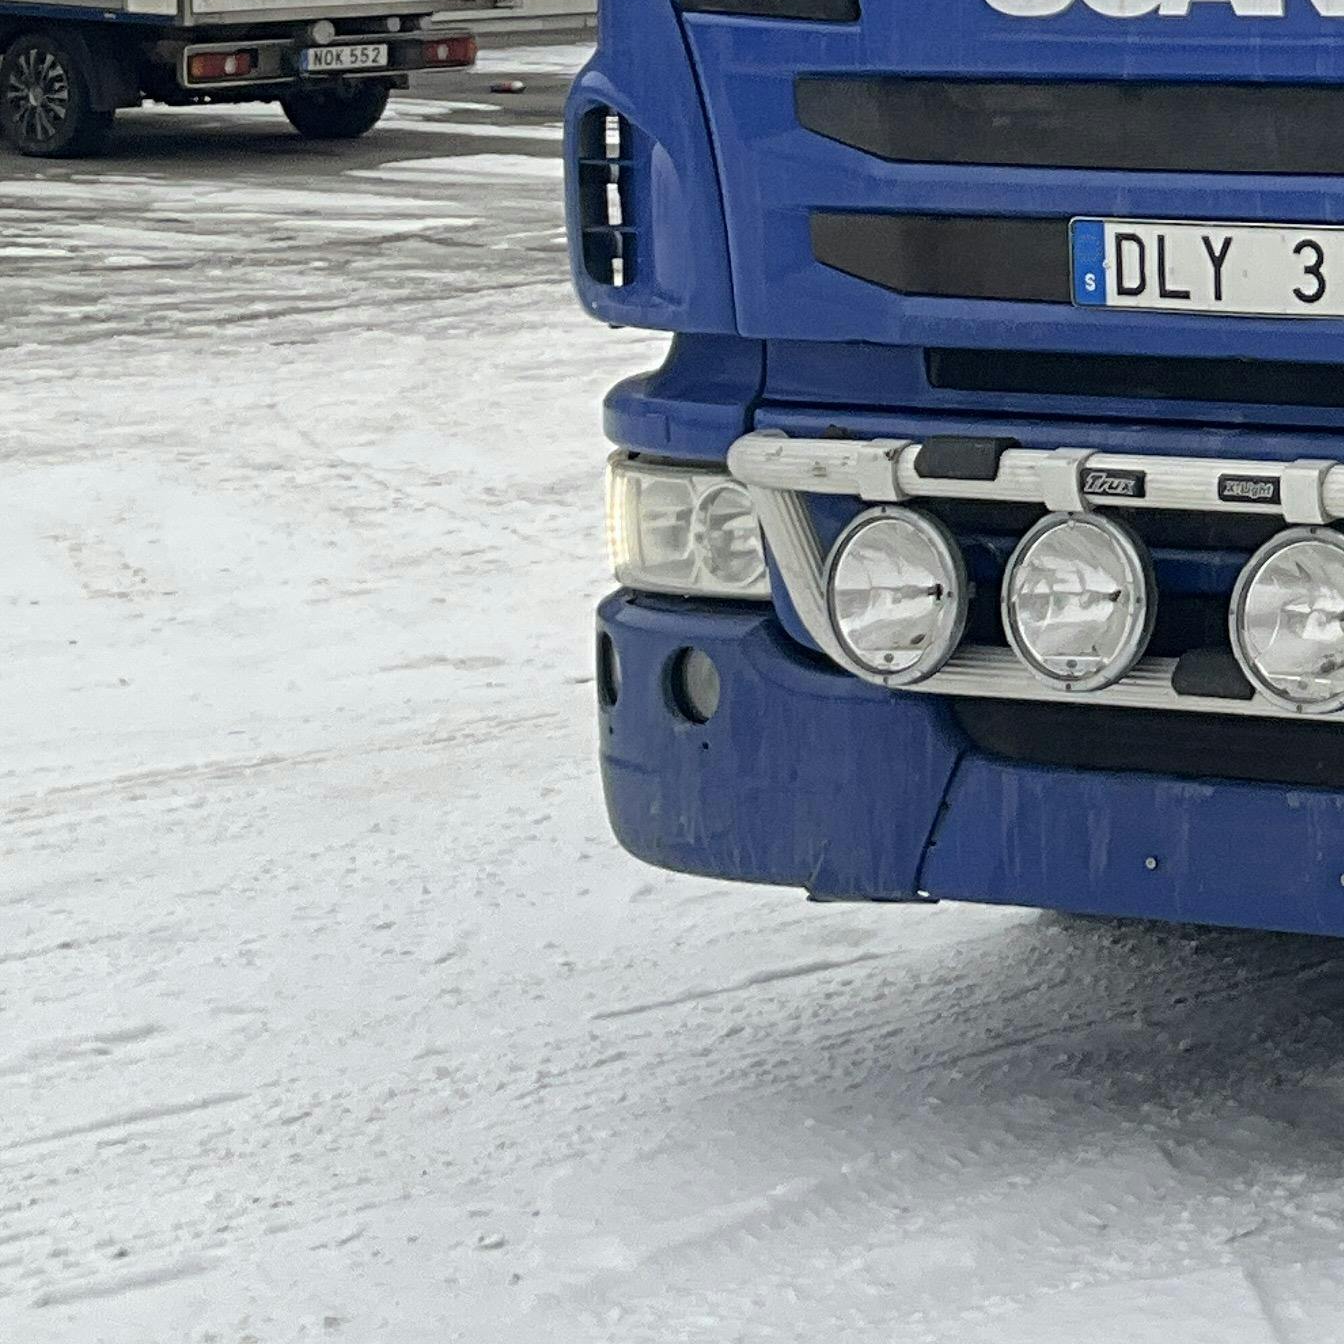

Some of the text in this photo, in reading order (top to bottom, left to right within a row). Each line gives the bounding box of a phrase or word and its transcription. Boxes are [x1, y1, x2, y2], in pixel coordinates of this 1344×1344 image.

[313, 46, 381, 66] NOK 552
[1084, 272, 1096, 292] S
[1114, 231, 1233, 302] DLY
